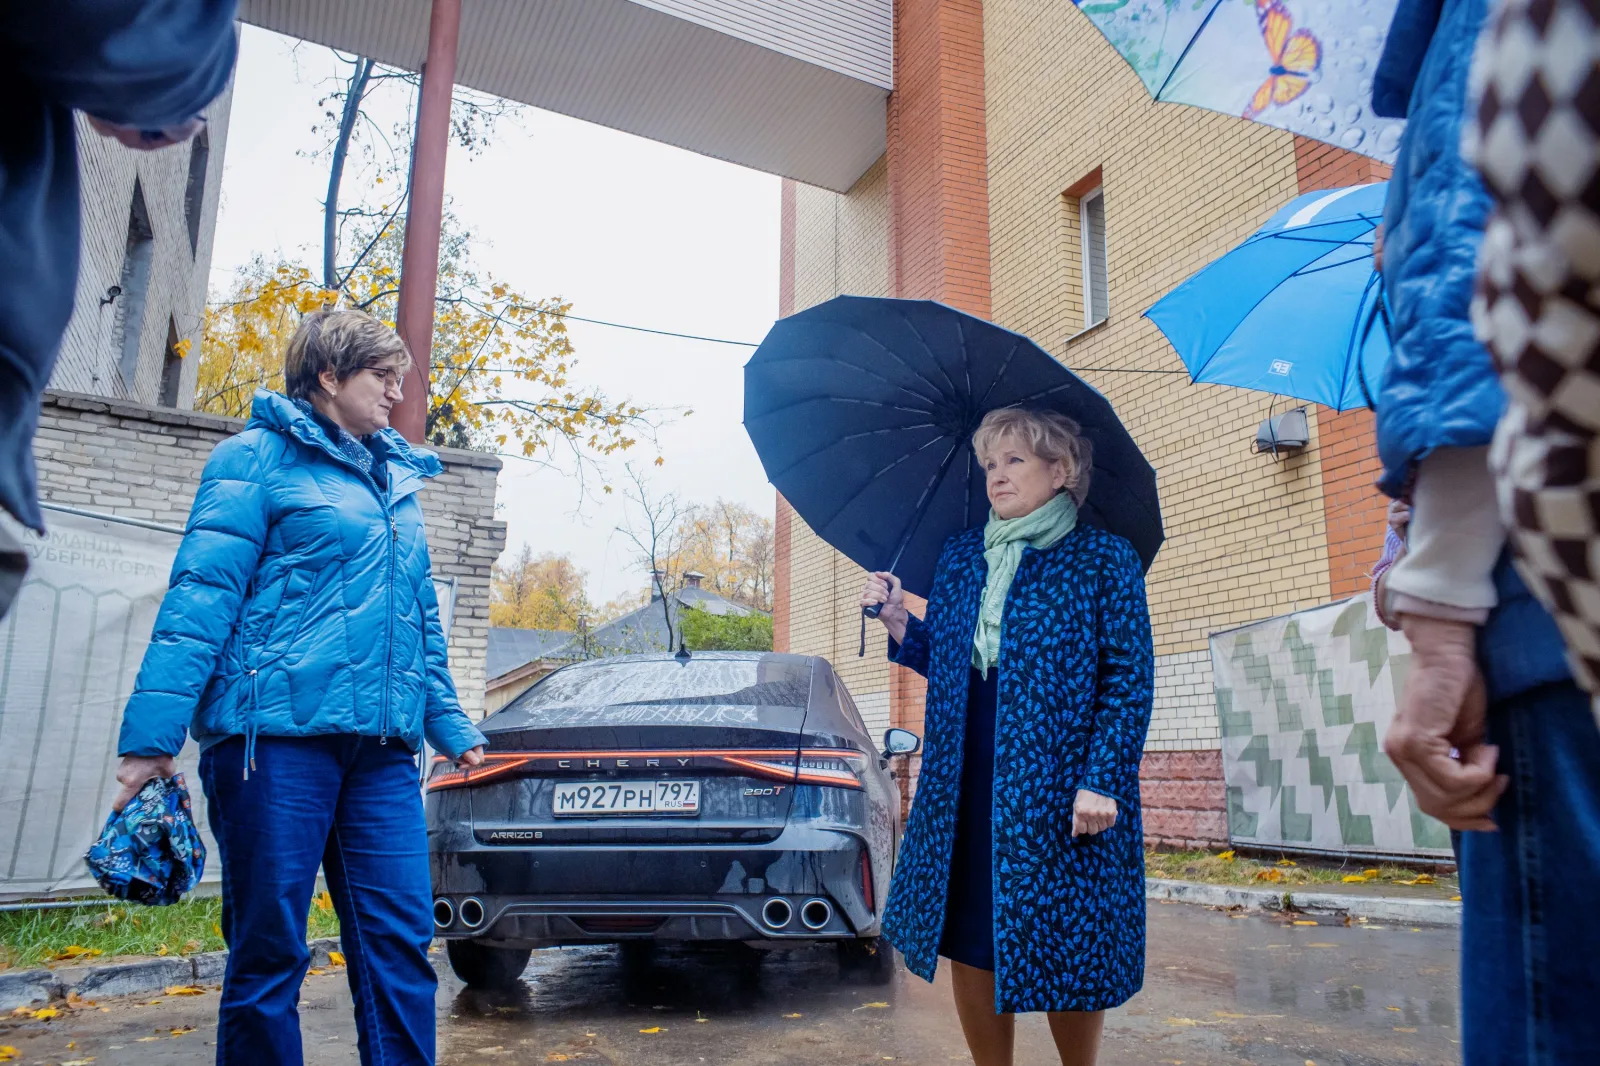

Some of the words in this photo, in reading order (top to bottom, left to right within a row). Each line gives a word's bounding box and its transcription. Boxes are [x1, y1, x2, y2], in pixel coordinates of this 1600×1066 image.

[558, 758, 690, 768] CHERY
[658, 783, 694, 801] 797
[743, 785, 786, 796] 290T
[664, 800, 682, 808] RUS
[490, 831, 533, 839] ARRIZO
